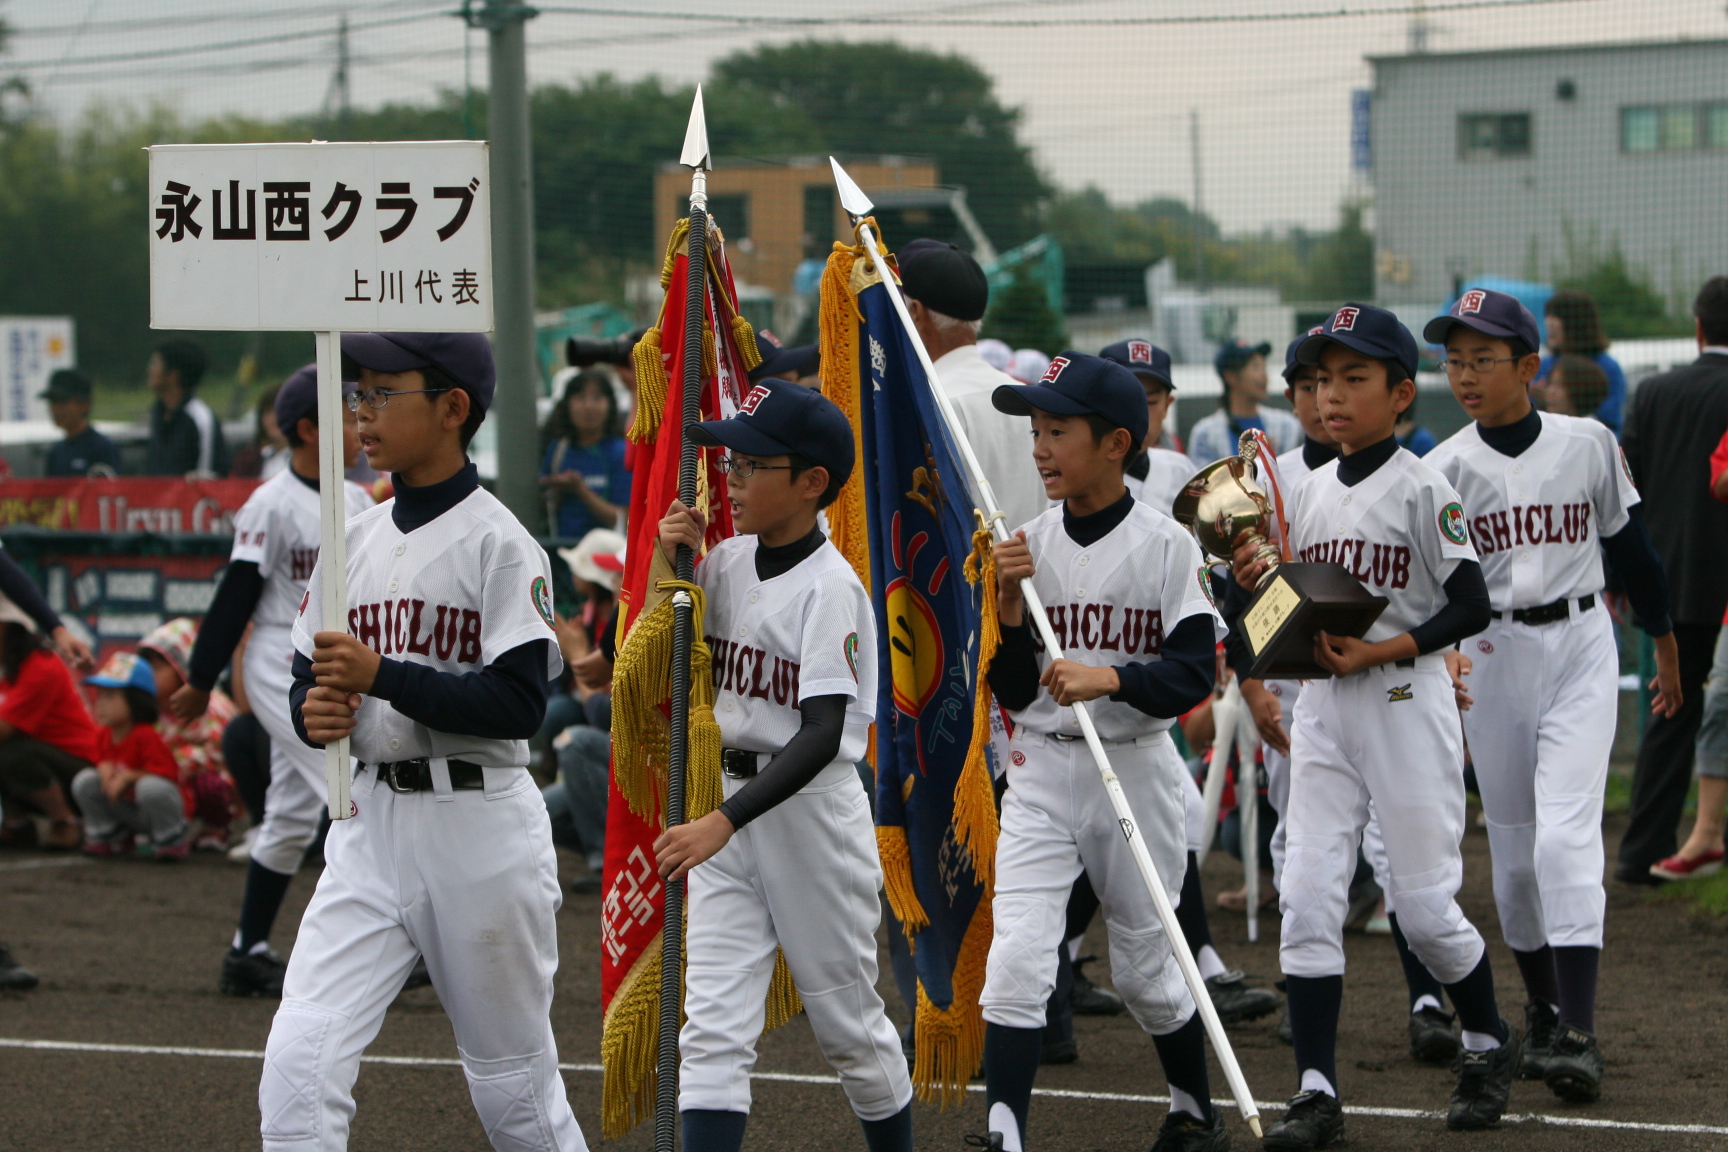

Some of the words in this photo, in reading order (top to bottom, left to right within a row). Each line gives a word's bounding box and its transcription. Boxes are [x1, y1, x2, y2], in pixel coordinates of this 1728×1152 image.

[155, 177, 481, 243] 永山西クラブ
[344, 268, 480, 305] 上川代表
[1459, 290, 1486, 315] 西
[1332, 307, 1359, 332] 西
[1039, 356, 1071, 383] 西
[1128, 341, 1152, 365] 西
[738, 385, 771, 416] 西
[1467, 503, 1590, 556] ISHICLUB
[347, 598, 482, 664] SHICLUB
[606, 881, 661, 967] パーラー
